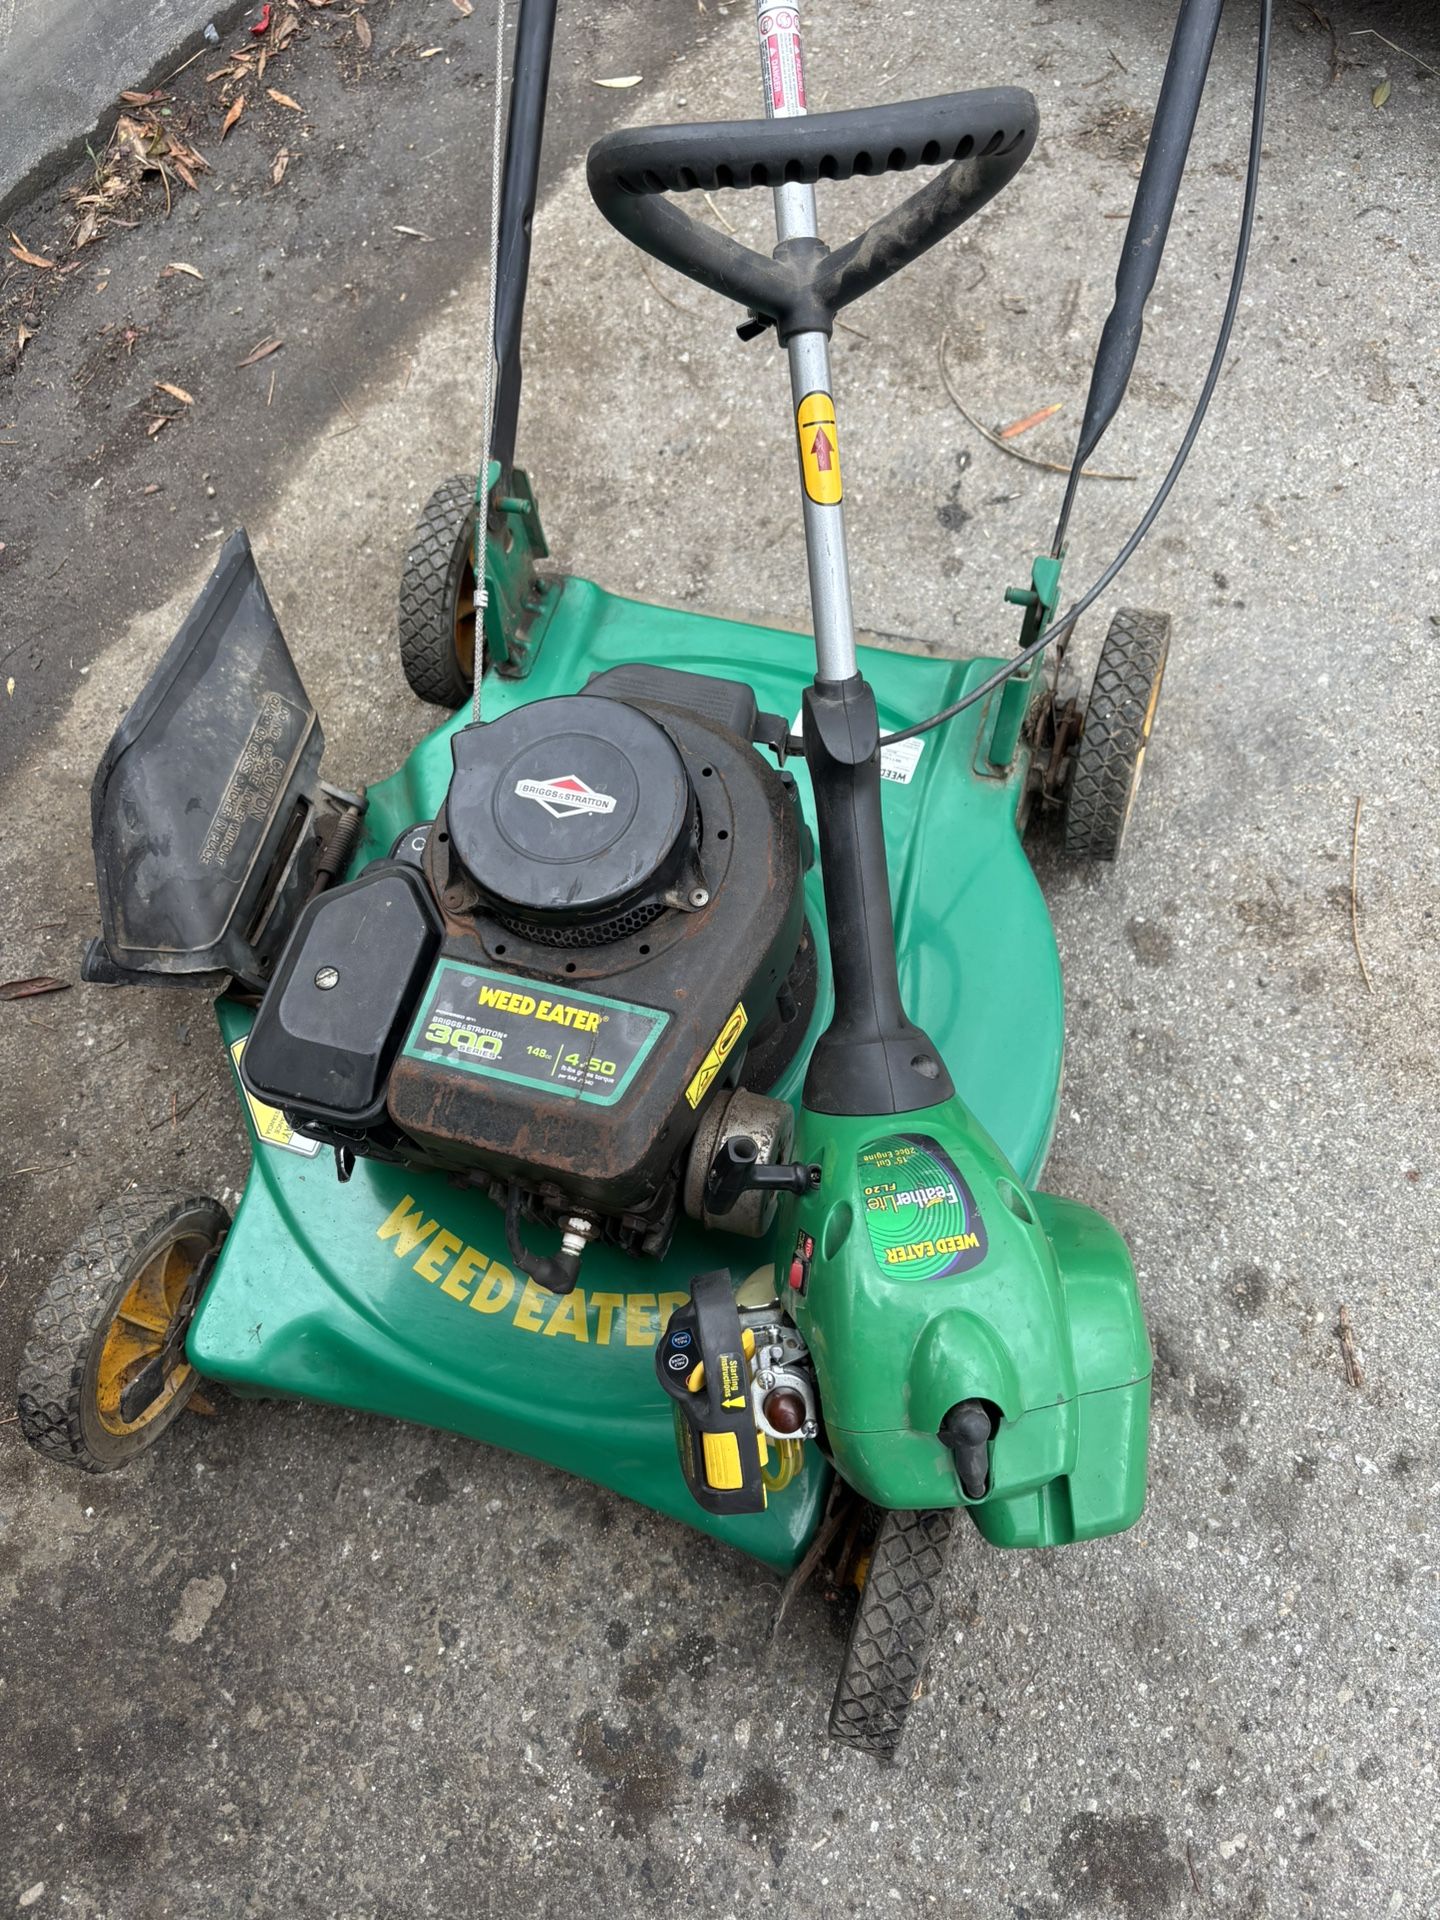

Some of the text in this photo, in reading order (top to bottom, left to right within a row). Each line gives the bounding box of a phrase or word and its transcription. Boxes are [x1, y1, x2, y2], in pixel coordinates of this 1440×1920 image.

[279, 706, 289, 721] DO
[201, 696, 280, 865] GUARD OR GRASS CATCHER IN PLACE
[249, 743, 273, 787] OPERATE
[234, 786, 255, 822] MOWER
[250, 757, 285, 822] CAUTION
[215, 823, 240, 865] WITHOUT
[478, 986, 601, 1032] WEED EATER
[425, 1023, 503, 1056] 300
[458, 1044, 496, 1059] SERIES
[564, 1053, 616, 1075] 4.50
[863, 1147, 916, 1161] 20cc Engine
[876, 1159, 891, 1167] Cut
[865, 1183, 896, 1195] FL20
[867, 1184, 958, 1213] FeatherLite
[376, 1194, 515, 1315] WEED
[885, 1232, 980, 1264] WEED EATER
[720, 1355, 731, 1398] Instructions
[730, 1360, 739, 1391] Starting
